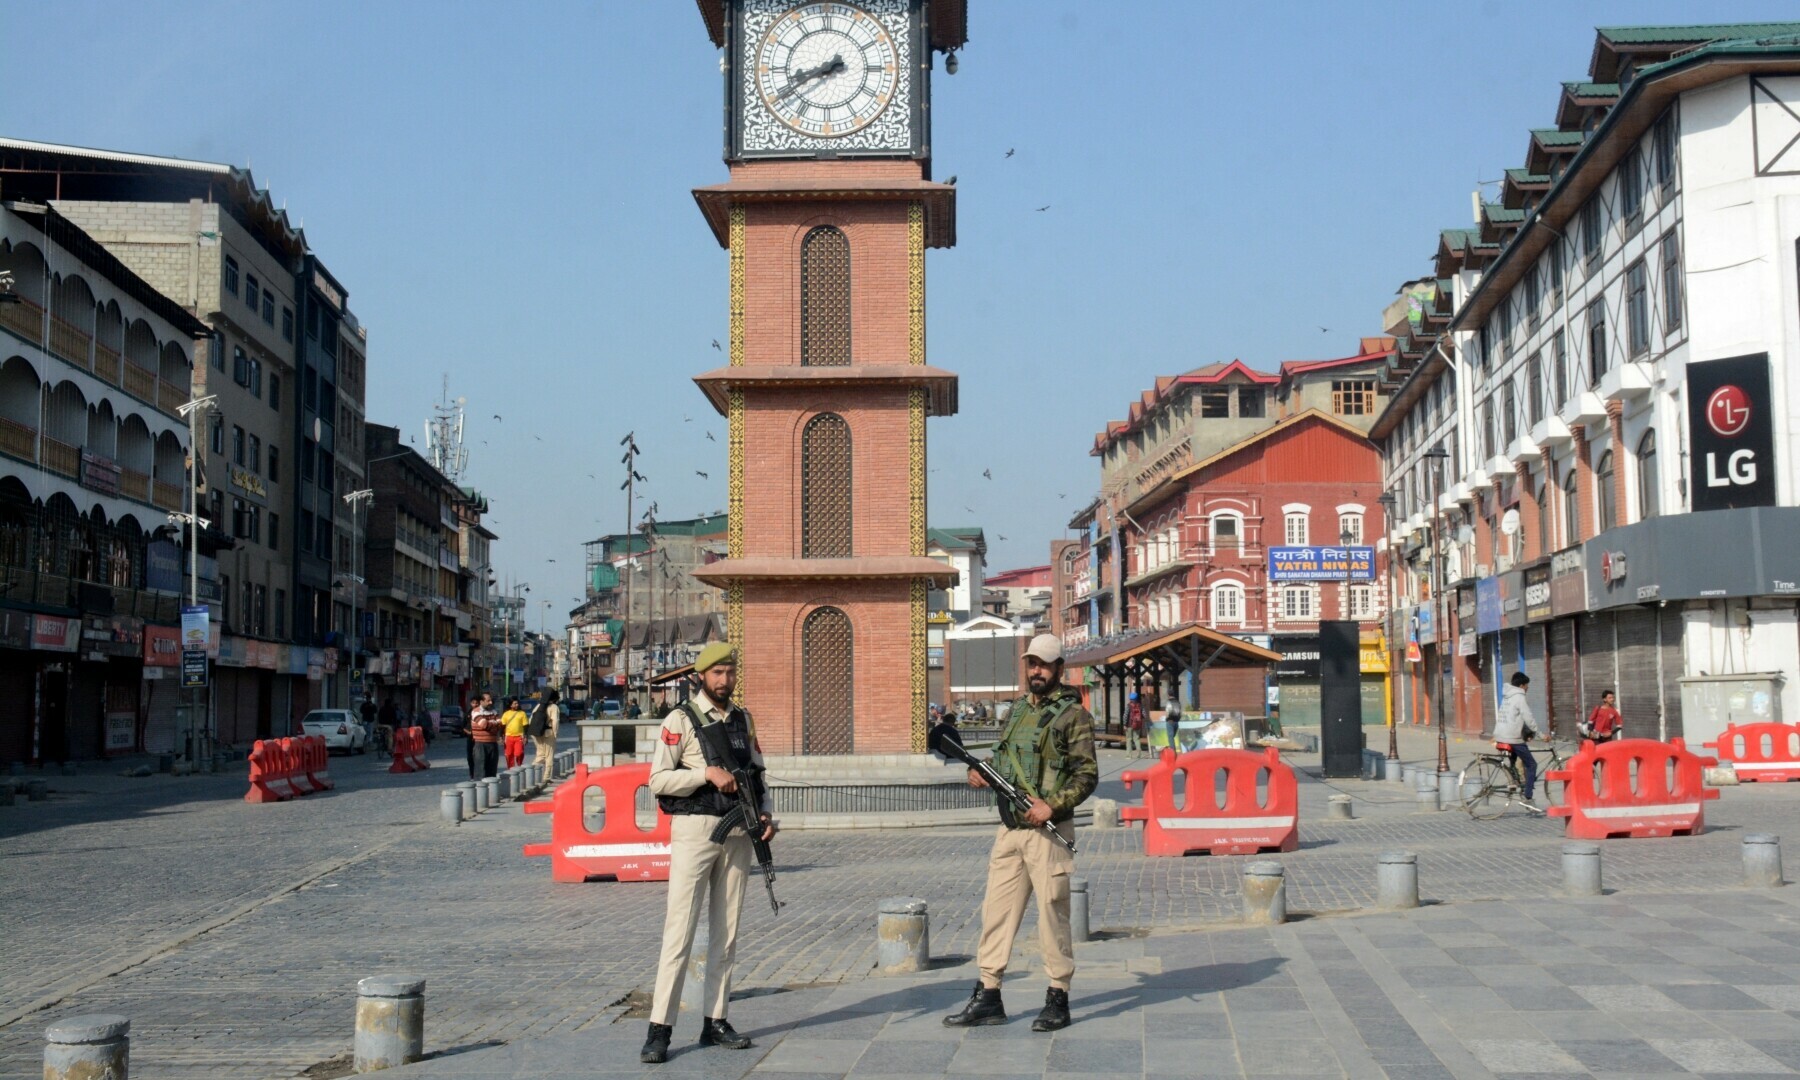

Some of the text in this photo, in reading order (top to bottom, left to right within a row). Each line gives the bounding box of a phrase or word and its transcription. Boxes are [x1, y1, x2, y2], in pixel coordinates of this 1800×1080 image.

[1706, 448, 1757, 488] LG
[1272, 548, 1316, 561] यात्री
[1275, 562, 1369, 570] YATRI NIWAS
[1773, 580, 1796, 589] Time
[37, 619, 66, 636] LIBERTY
[353, 670, 361, 680] P
